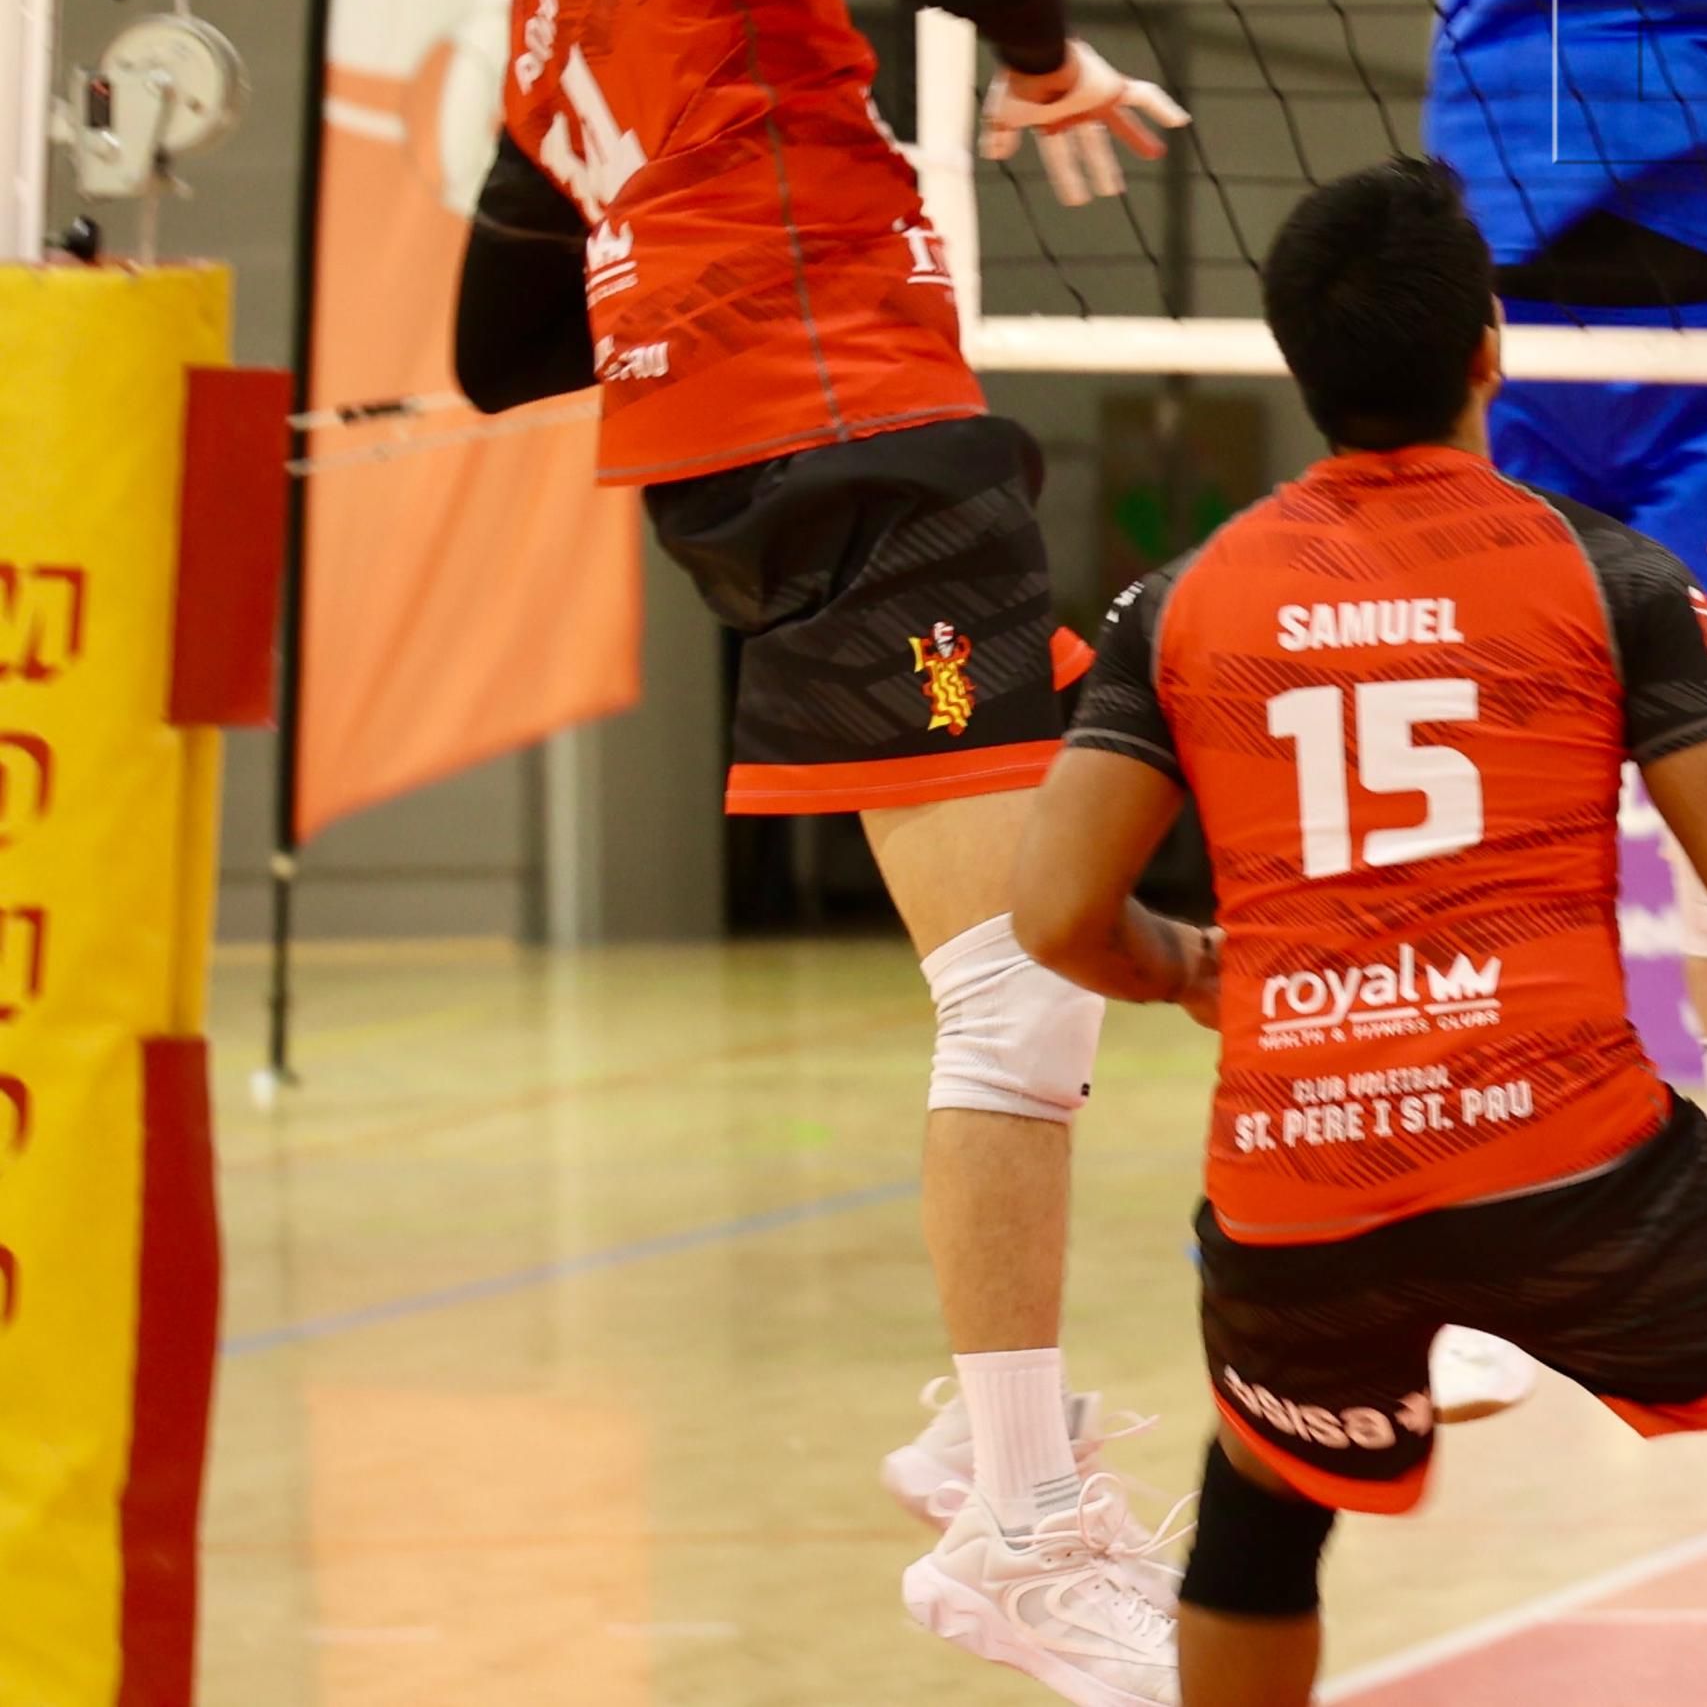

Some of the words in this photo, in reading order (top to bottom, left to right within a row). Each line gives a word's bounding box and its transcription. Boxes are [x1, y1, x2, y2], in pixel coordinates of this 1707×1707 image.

[1276, 597, 1464, 652] SAMUEL
[1267, 677, 1484, 880] 15
[1260, 941, 1422, 1026] royal
[1281, 1101, 1366, 1148] PERE
[1371, 1098, 1394, 1138] I
[1460, 1079, 1535, 1127] PAU
